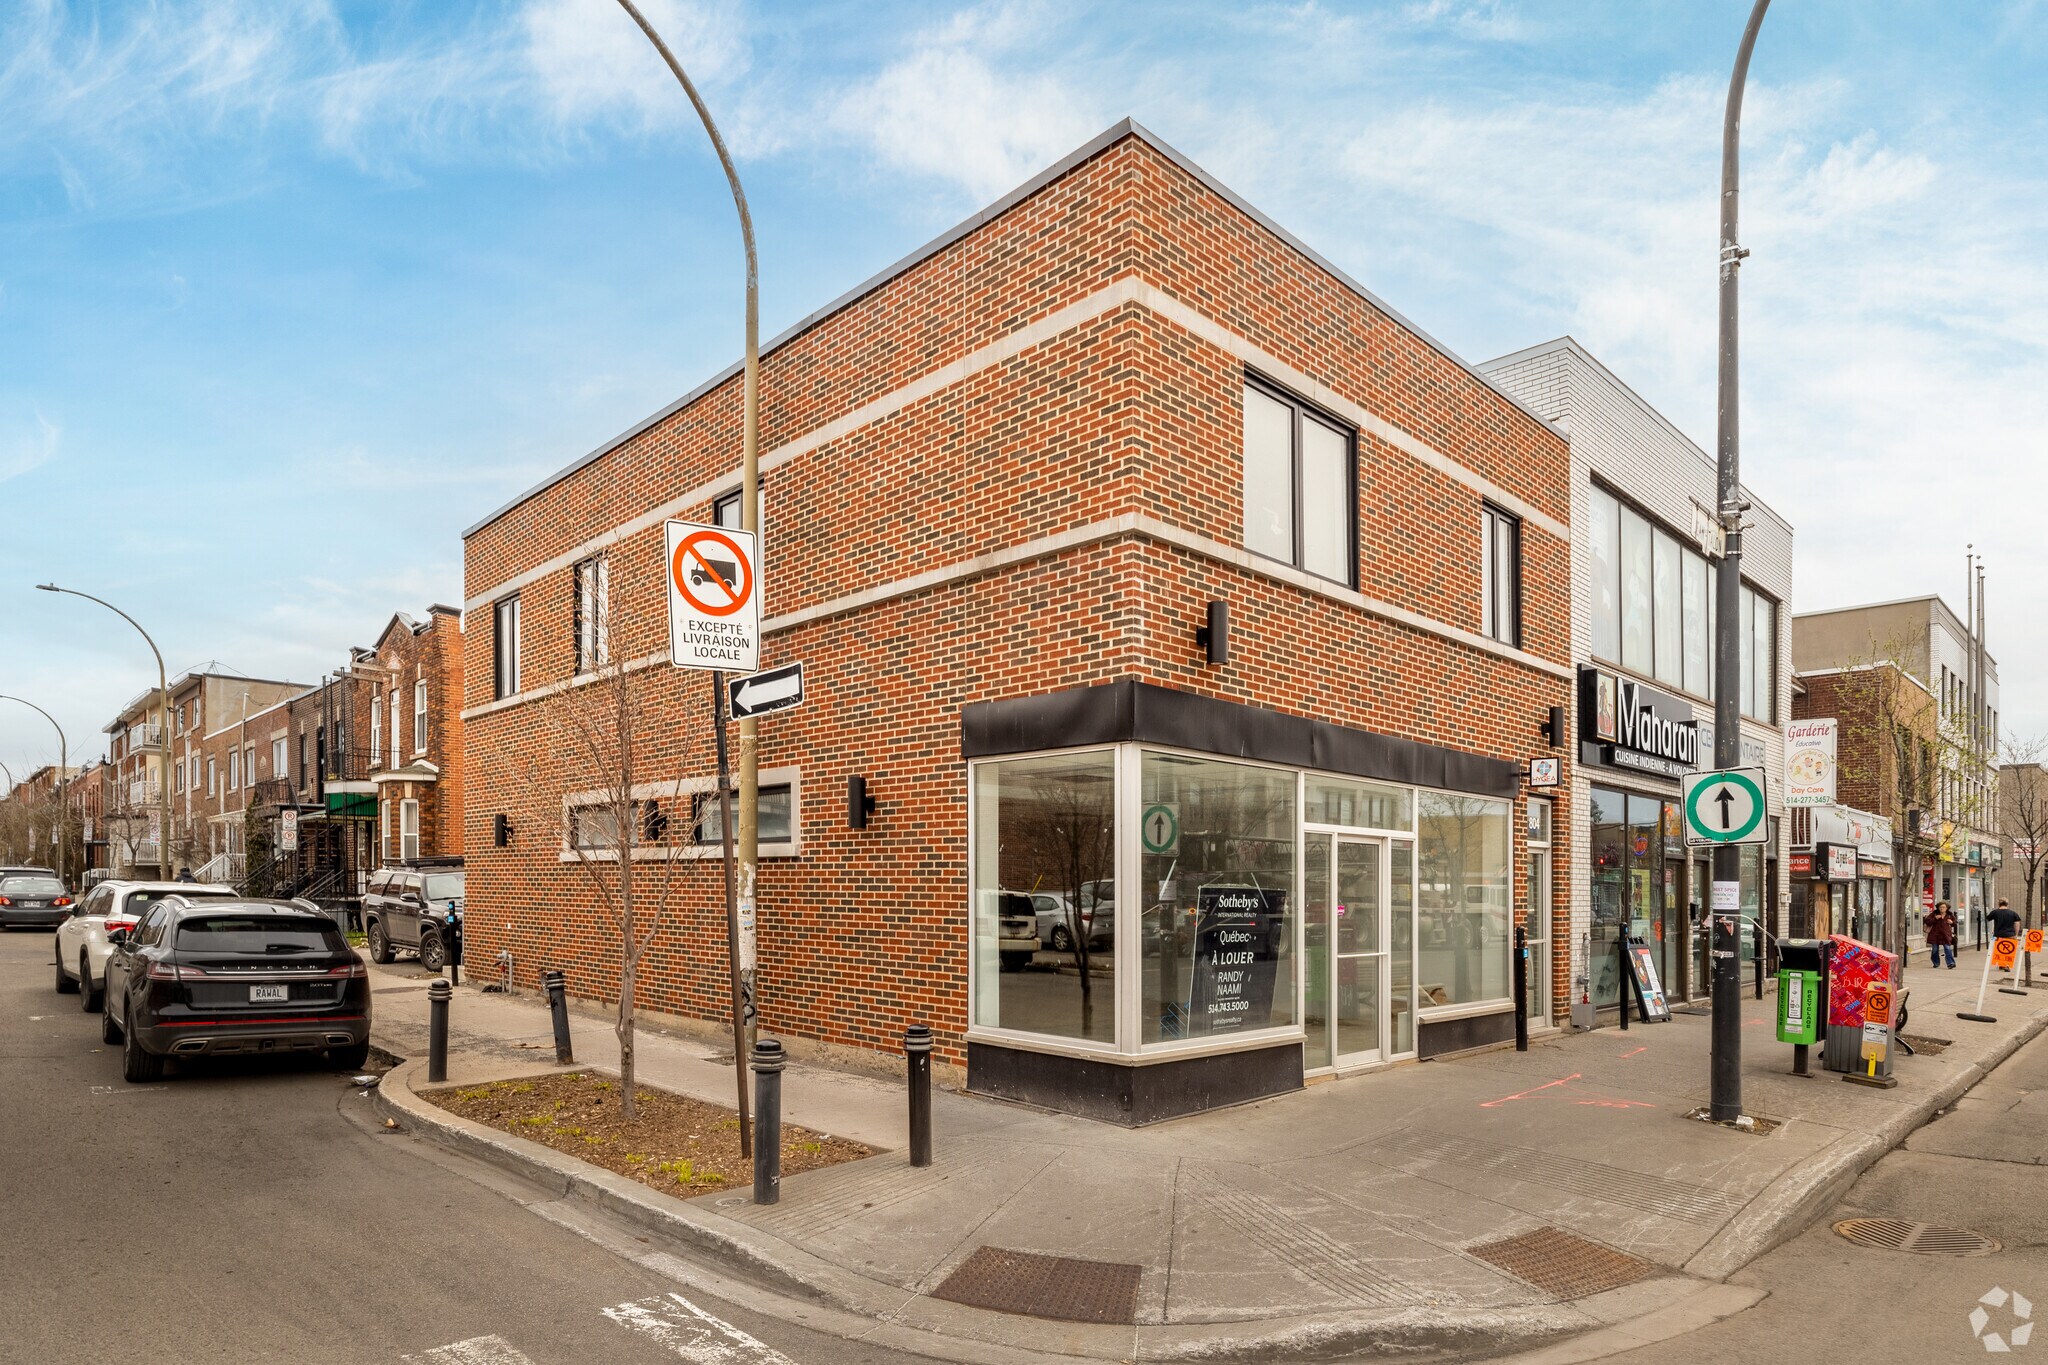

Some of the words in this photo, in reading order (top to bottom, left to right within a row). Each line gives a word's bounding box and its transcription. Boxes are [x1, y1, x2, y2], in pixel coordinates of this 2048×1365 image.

[689, 620, 743, 635] EXCEPTÉ
[683, 633, 750, 648] LIVRAISON
[694, 647, 740, 660] LOCALE
[1617, 677, 1700, 764] Maharani
[1788, 723, 1830, 742] Garderie
[1614, 750, 1639, 766] CUISINE
[1639, 755, 1666, 772] INDIENNE
[1533, 775, 1556, 783] HYGEA
[1791, 787, 1805, 795] Day
[1807, 786, 1824, 794] Care
[1786, 795, 1830, 804] 514-277-3457
[1528, 817, 1540, 830] 804
[1218, 894, 1259, 911] Sotheby's
[1219, 930, 1250, 946] Québec
[1211, 950, 1218, 966] À
[1220, 952, 1254, 965] LOUER
[1217, 971, 1244, 983] RANDY
[256, 988, 282, 998] RAWAL
[1217, 983, 1242, 996] NAAMI
[1208, 1000, 1249, 1014] 514.743.5000
